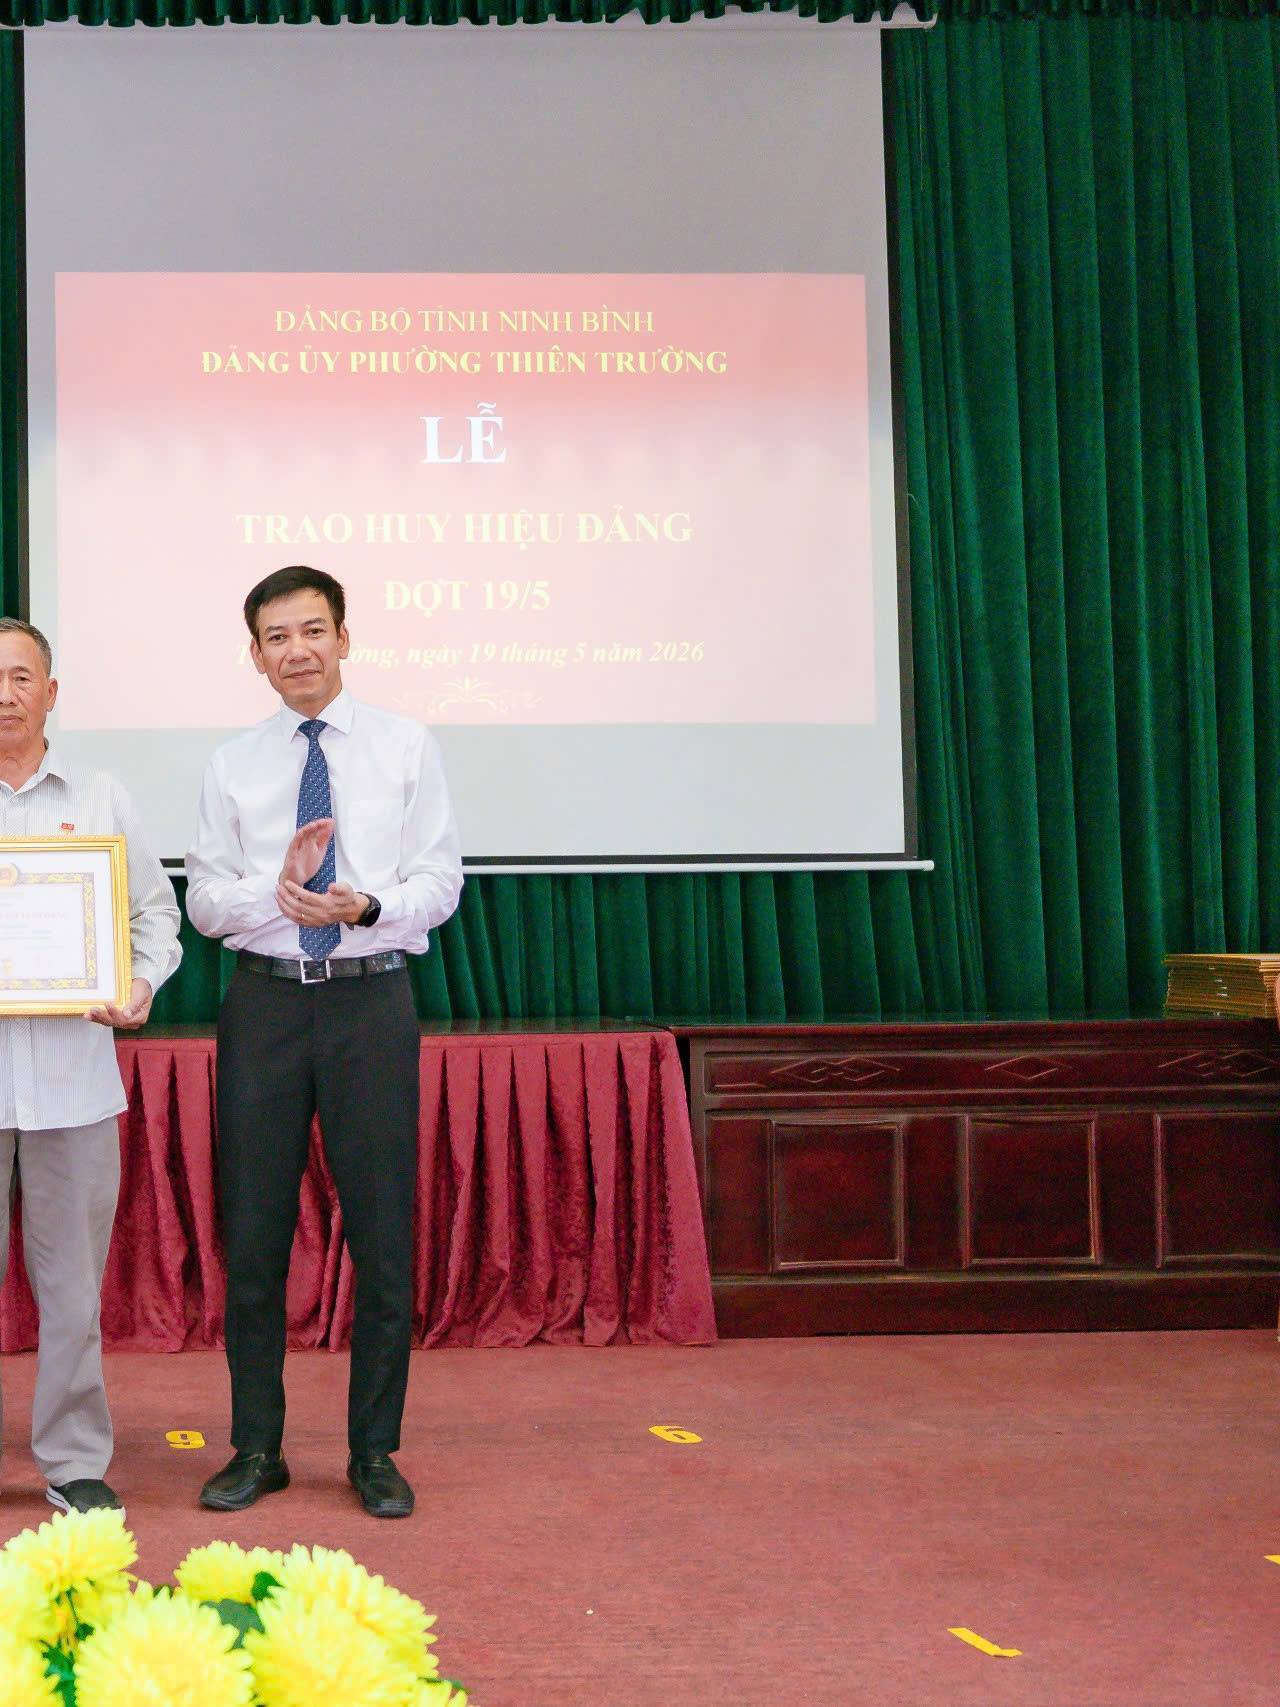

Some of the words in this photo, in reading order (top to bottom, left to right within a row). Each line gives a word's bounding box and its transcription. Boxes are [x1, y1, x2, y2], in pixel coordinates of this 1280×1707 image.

[274, 304, 364, 333] ĐẢNG
[369, 306, 412, 336] BỘ
[498, 311, 575, 332] NINH
[581, 304, 655, 332] BÌNH
[350, 344, 482, 374] PHƯỜNG
[489, 344, 587, 374] THIÊN
[593, 344, 728, 374] TRƯỜNG
[418, 401, 508, 464] LỄ
[234, 512, 354, 545] TRAO
[364, 511, 453, 545] HUY
[462, 508, 566, 551] HIỆU
[575, 503, 696, 545] ĐẢNG
[383, 579, 470, 618] ĐỢT
[482, 579, 552, 611] 19/5
[406, 643, 463, 670] ngày
[464, 641, 497, 664] 19
[500, 641, 569, 669] tháng
[573, 641, 588, 664] 5
[592, 642, 643, 664] năm
[647, 640, 706, 664] 2026
